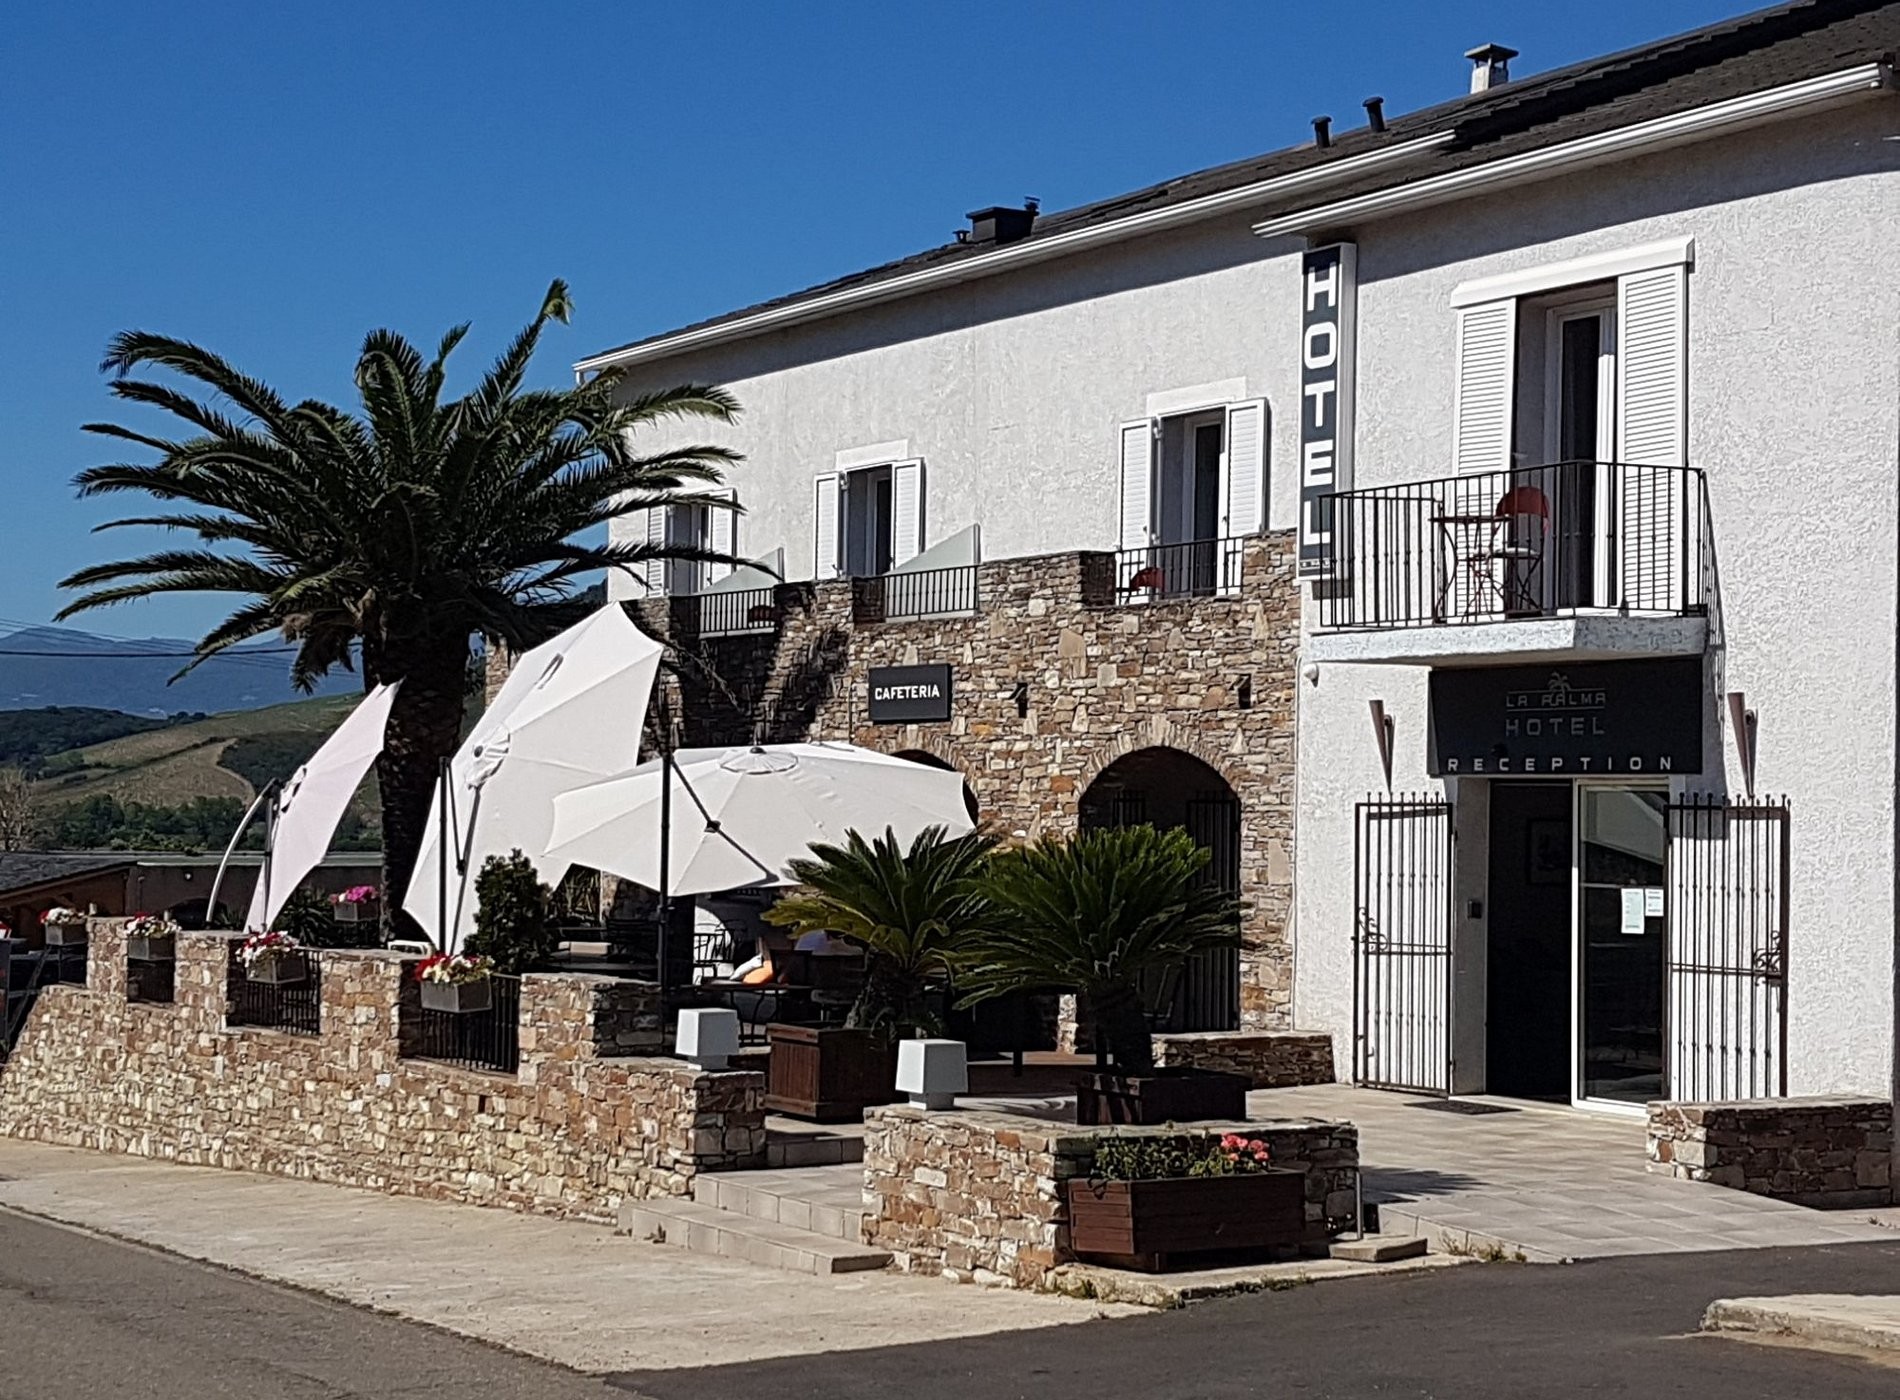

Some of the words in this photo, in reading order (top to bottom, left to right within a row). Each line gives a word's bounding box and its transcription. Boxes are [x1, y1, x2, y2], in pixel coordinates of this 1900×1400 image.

[1303, 261, 1337, 546] HOTEL
[874, 684, 940, 700] CAFETERIA
[1506, 695, 1528, 707] LA
[1541, 692, 1606, 707] PALMA
[1505, 717, 1605, 737] HOTEL
[1448, 756, 1671, 771] RECEPTION
